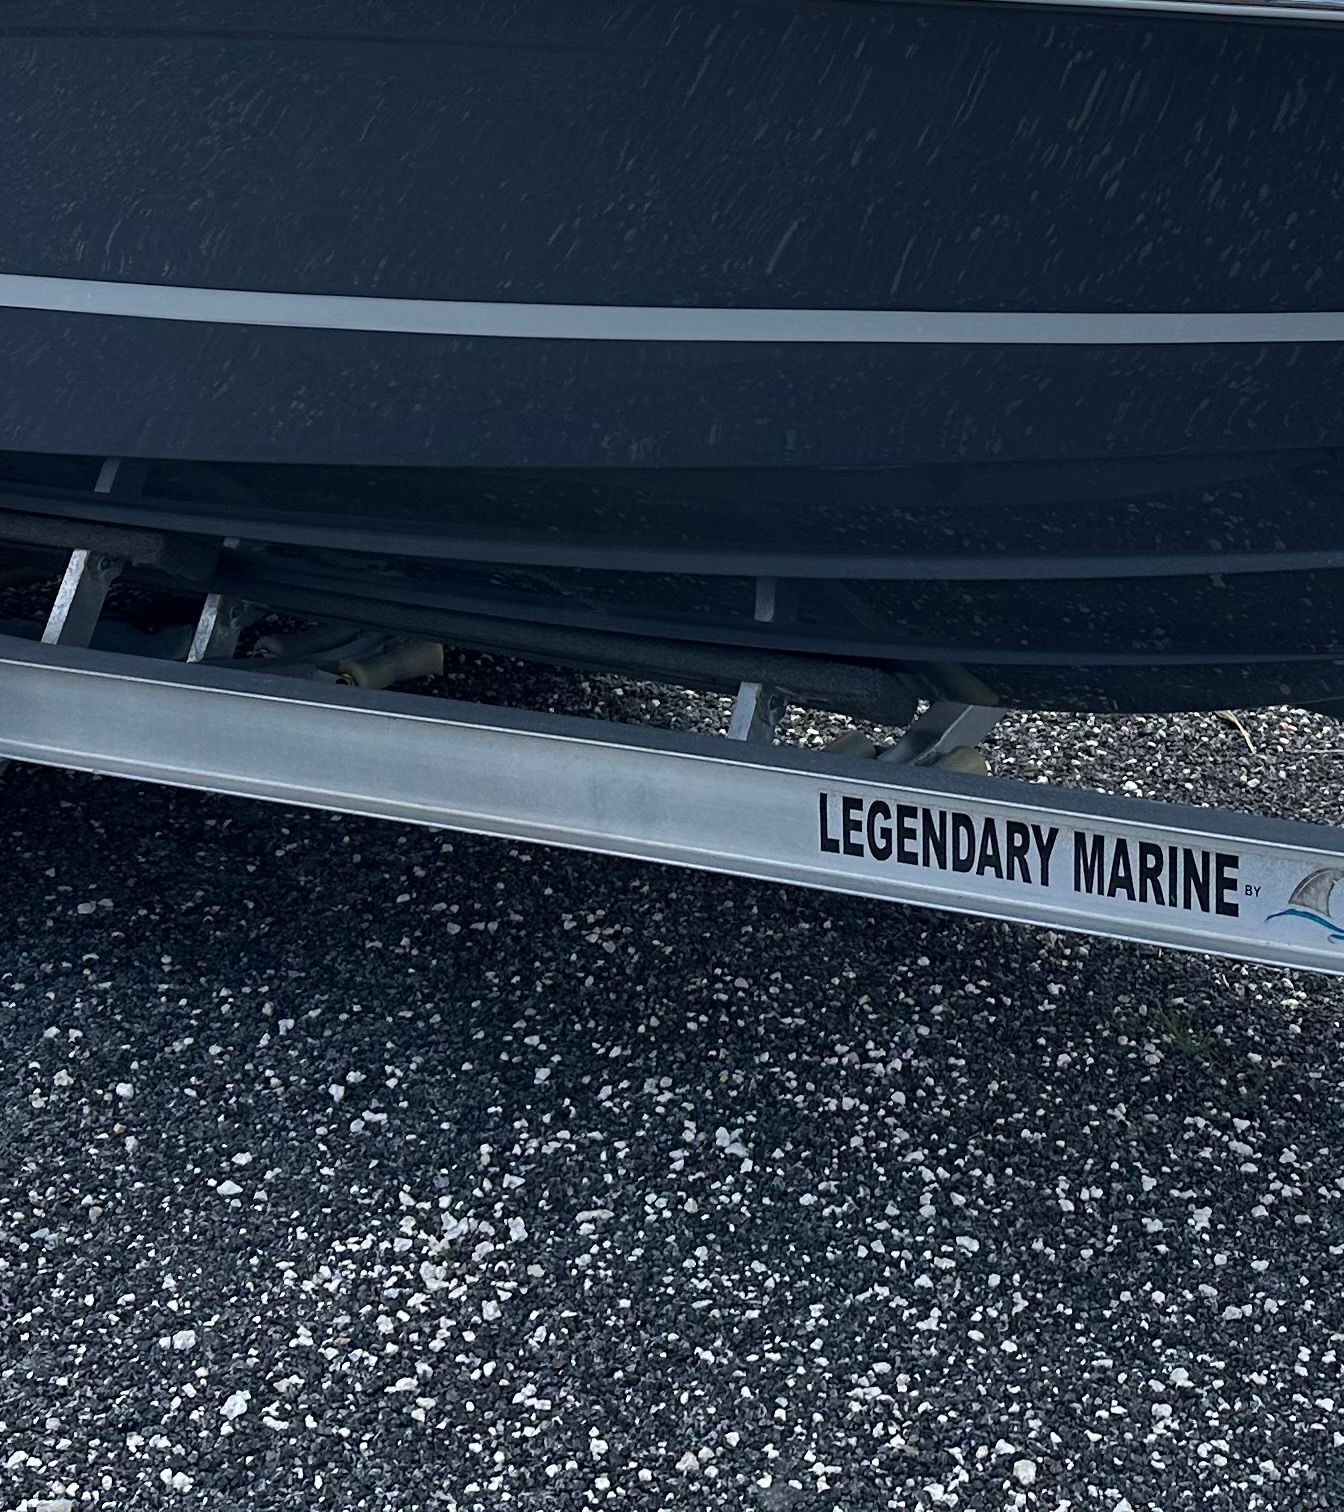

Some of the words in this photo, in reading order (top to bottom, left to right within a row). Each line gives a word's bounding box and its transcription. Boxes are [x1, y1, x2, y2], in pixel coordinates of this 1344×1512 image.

[819, 793, 1059, 887] LEGENDARY
[1073, 832, 1240, 918] MARINE
[1244, 884, 1262, 897] BY
